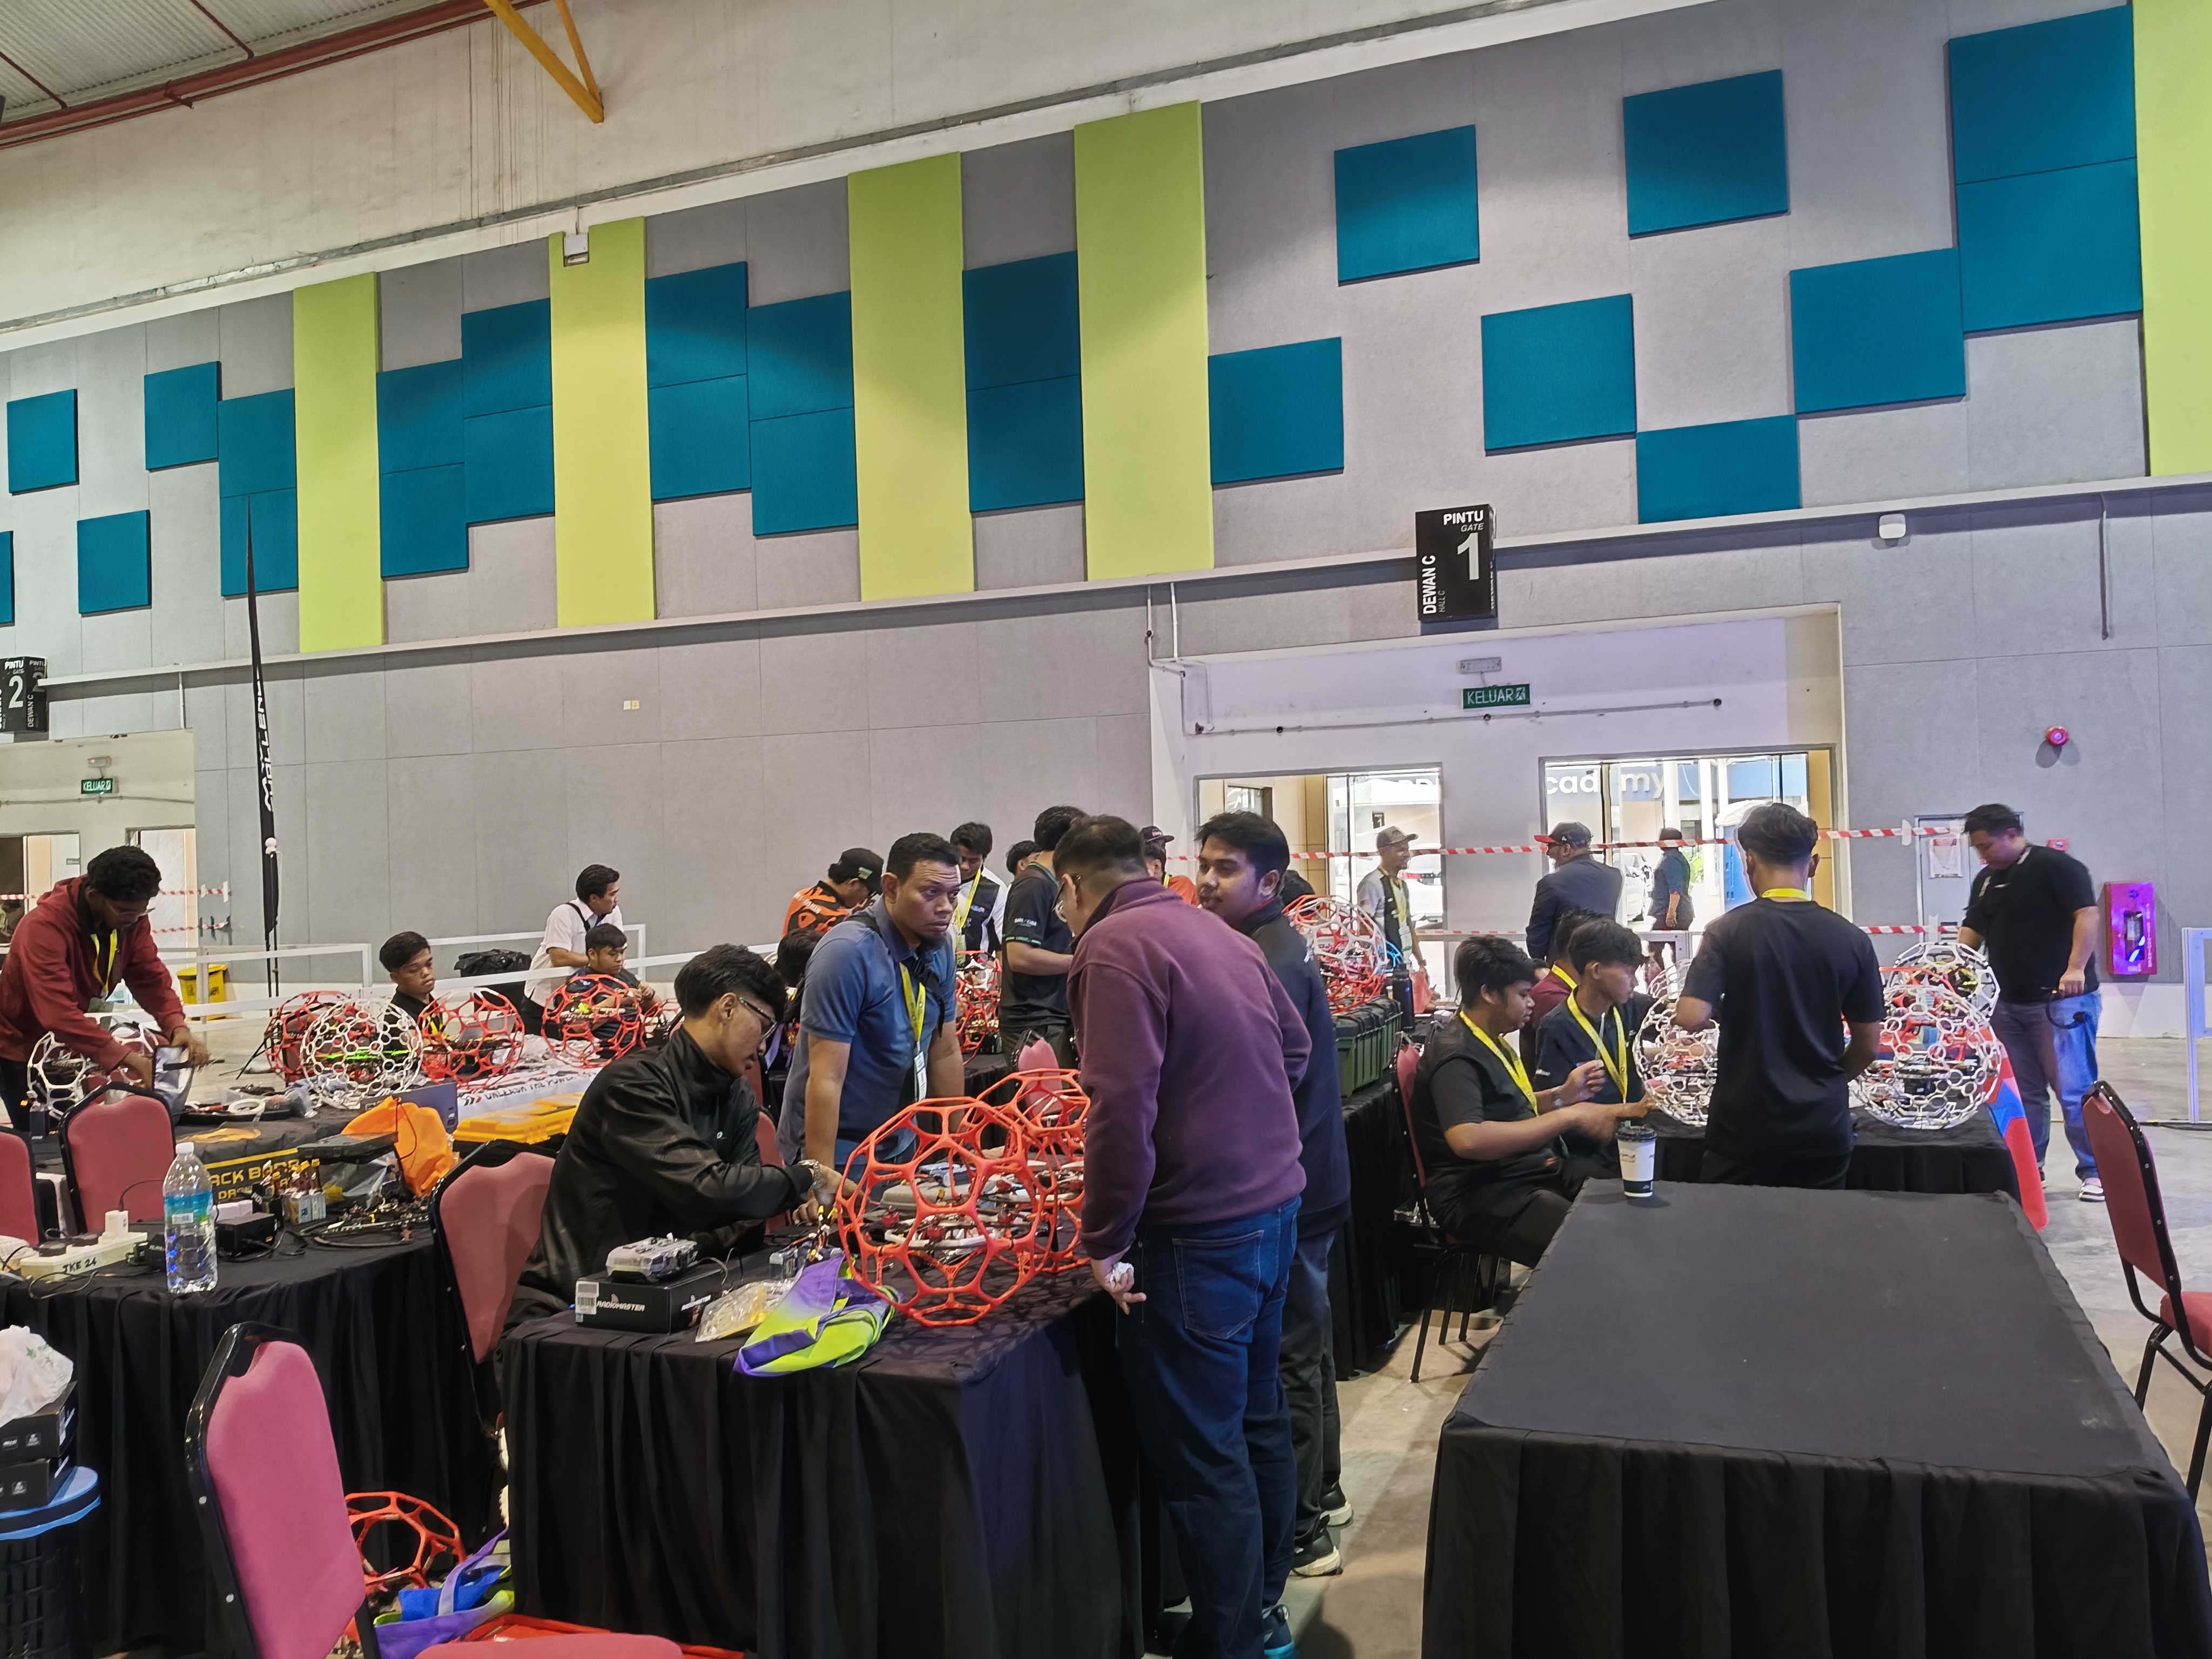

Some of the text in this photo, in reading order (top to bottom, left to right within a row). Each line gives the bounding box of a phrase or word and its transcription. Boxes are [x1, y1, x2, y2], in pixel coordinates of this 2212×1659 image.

[1444, 510, 1483, 525] PINTU
[1461, 522, 1485, 532] GATE
[1457, 532, 1479, 581] 1
[1421, 555, 1437, 614] DEWAN C
[1438, 596, 1446, 613] HALL
[4, 660, 24, 670] PINTU
[8, 675, 23, 709] 2
[1467, 688, 1513, 705] KELUAR
[83, 780, 106, 791] KELUAR
[211, 1170, 244, 1186] ACK
[85, 1257, 97, 1268] 24
[596, 1300, 645, 1312] RADIOMASTER
